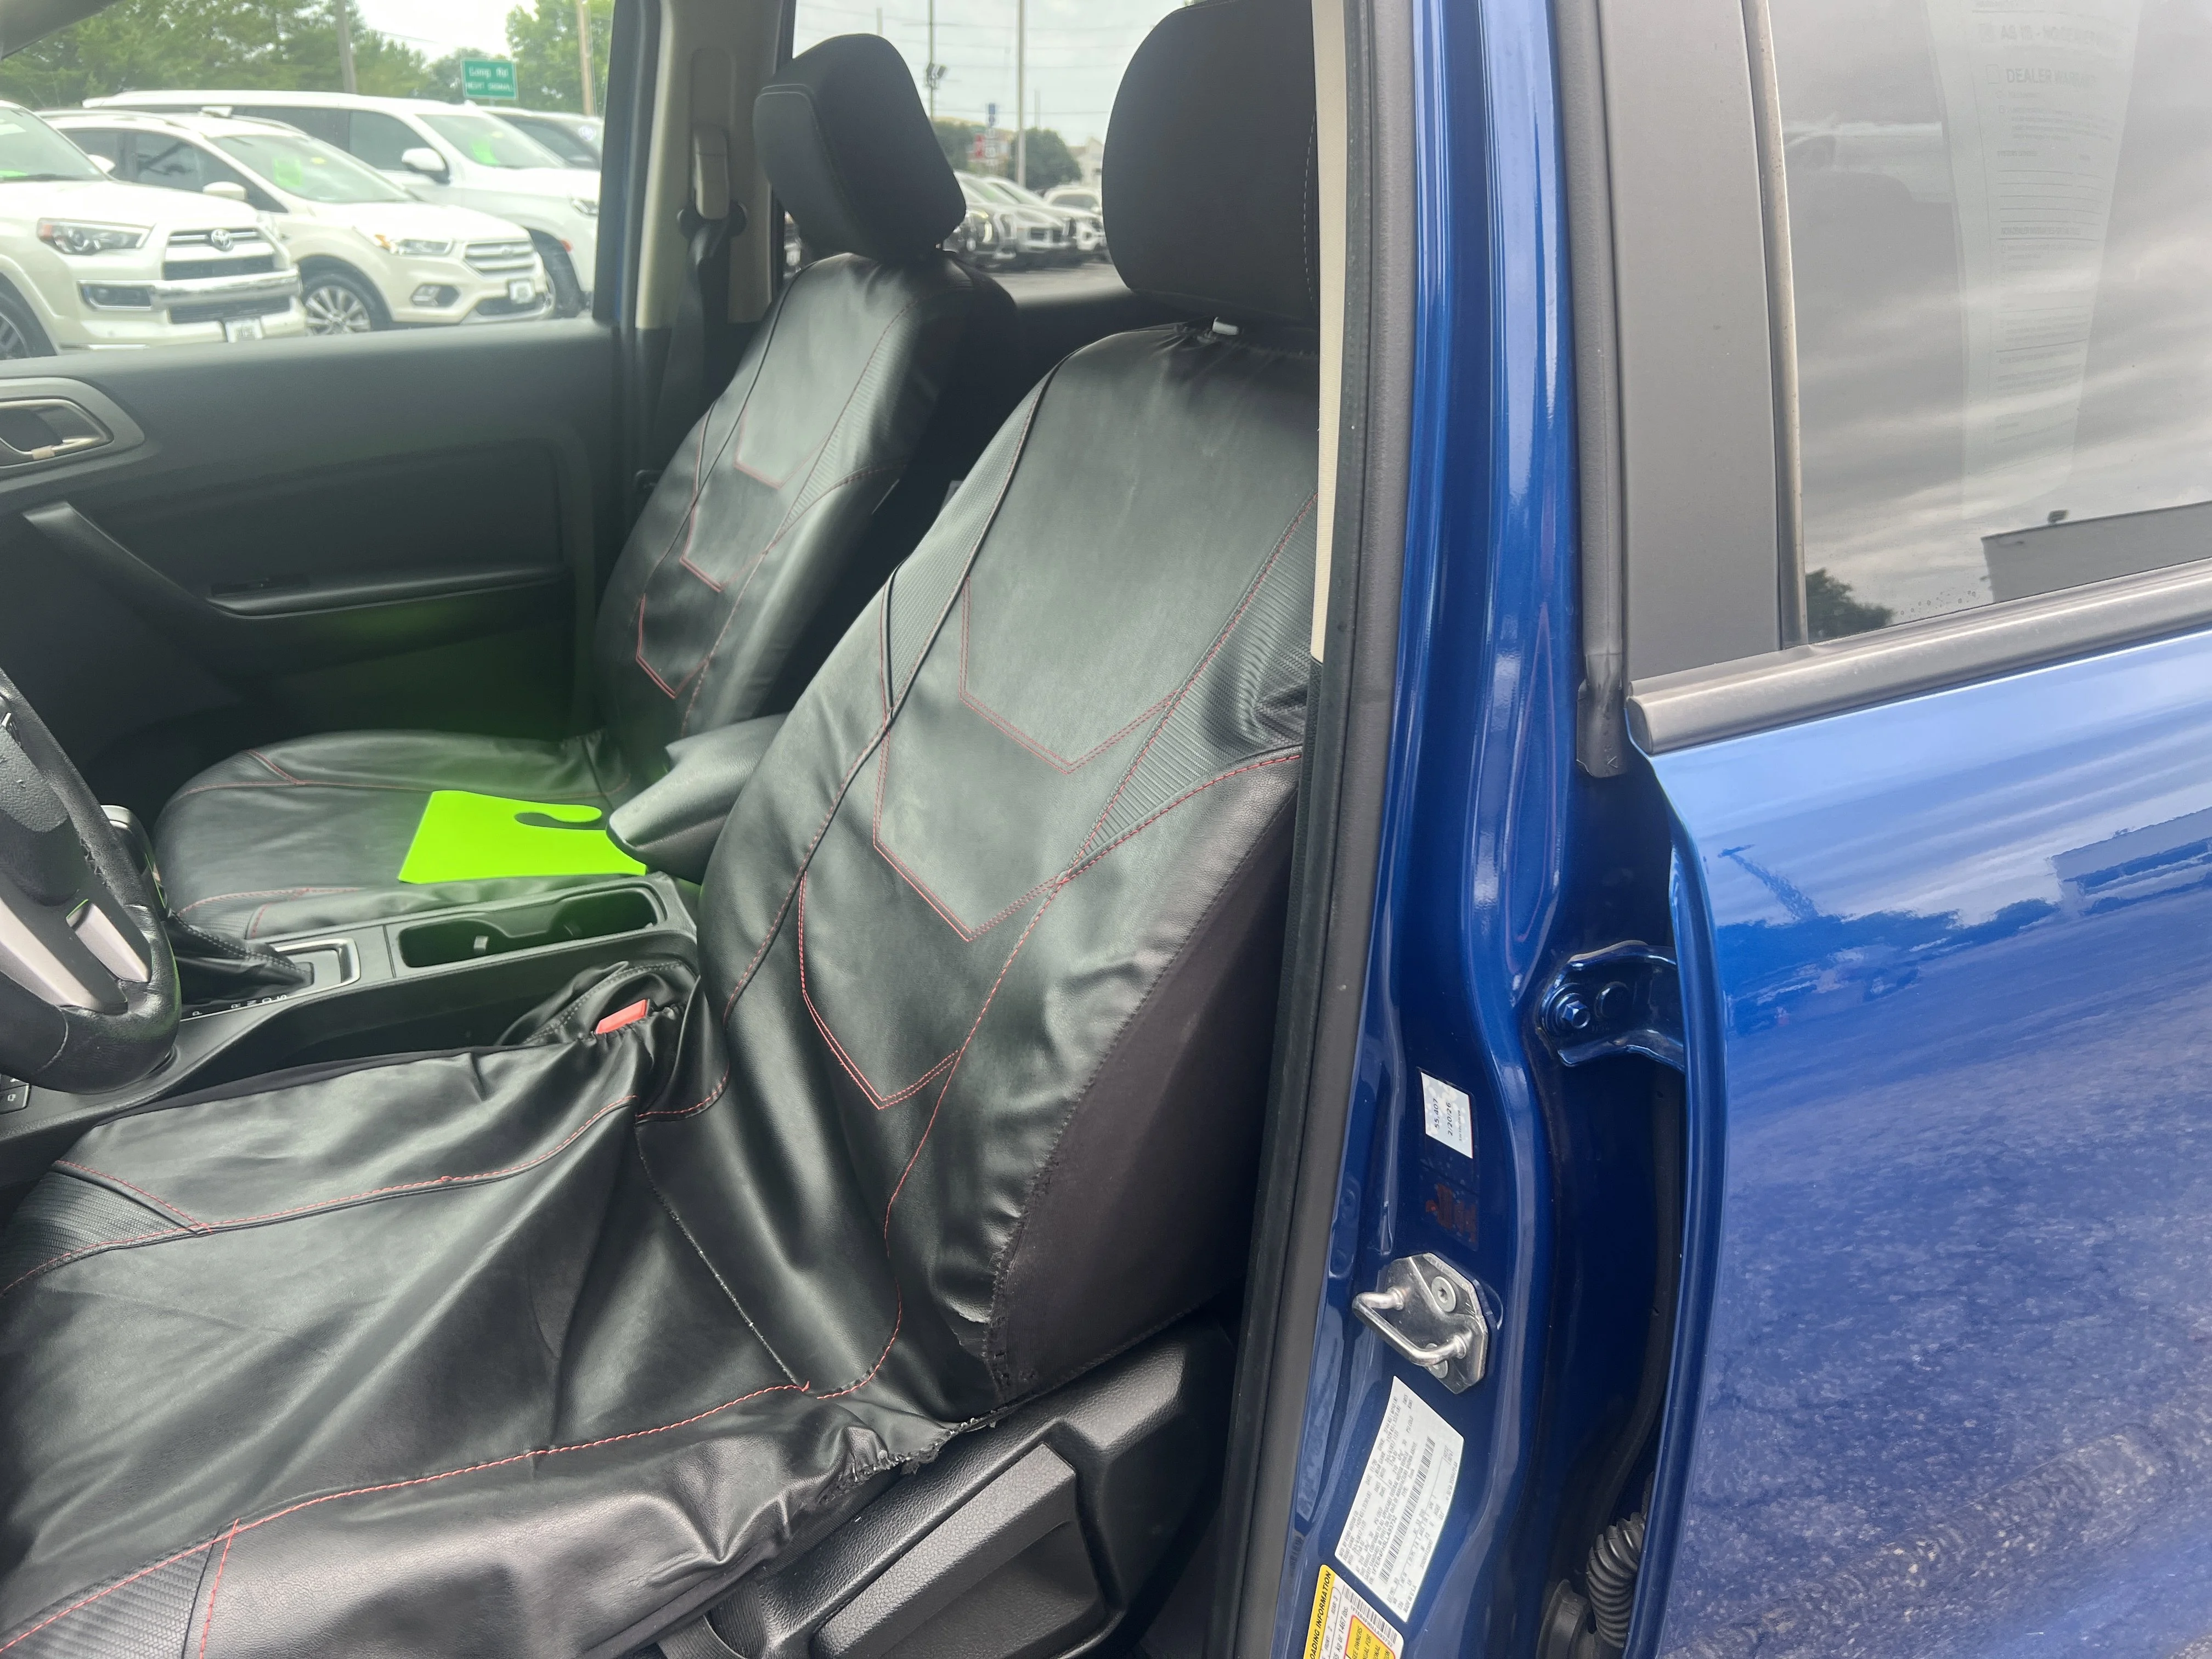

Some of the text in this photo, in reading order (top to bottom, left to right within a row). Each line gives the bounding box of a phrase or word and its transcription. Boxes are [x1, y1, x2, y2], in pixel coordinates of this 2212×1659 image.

[2006, 68, 2051, 83] DEALER
[1309, 1568, 1331, 1659] OADING INFORMATION
[1338, 1616, 1346, 1635] 1467
[1337, 1634, 1343, 1644] or
[1353, 1624, 1363, 1651] OWNERS
[1335, 1641, 1342, 1654] kg
